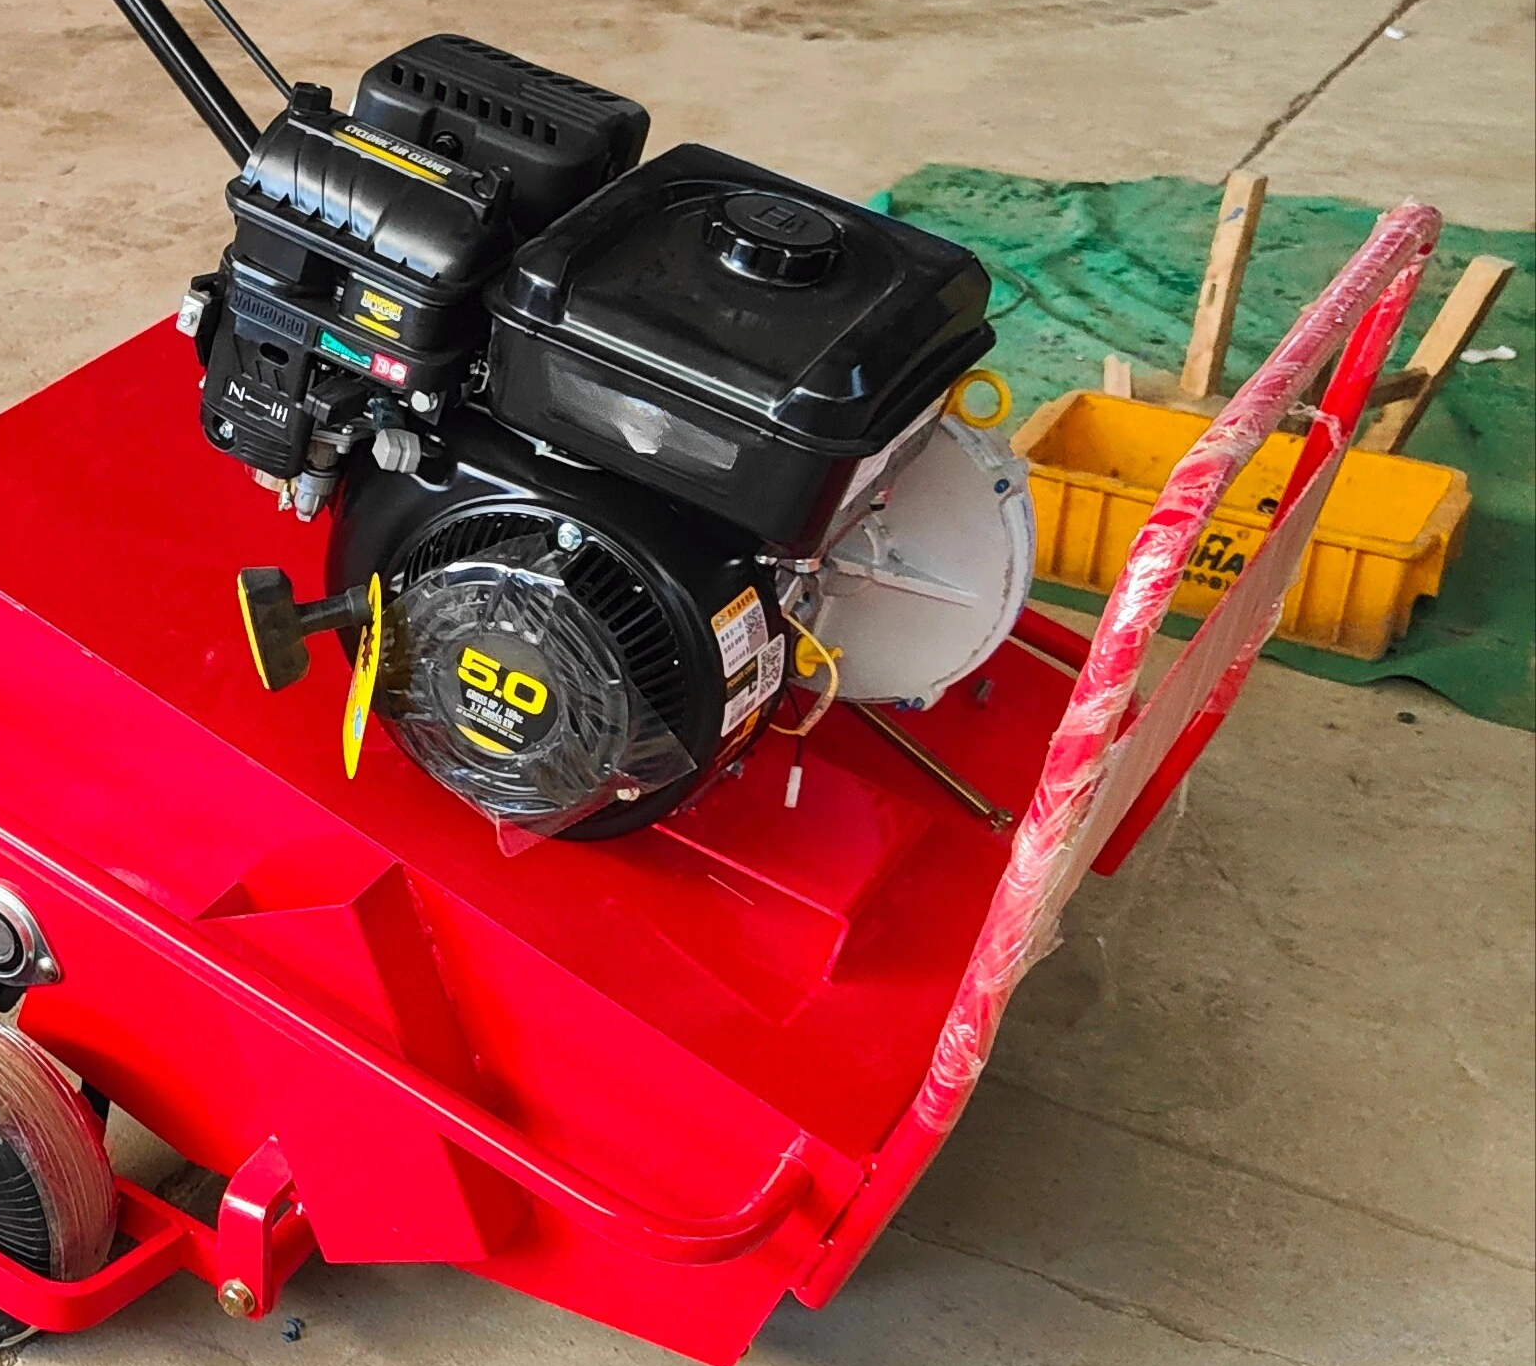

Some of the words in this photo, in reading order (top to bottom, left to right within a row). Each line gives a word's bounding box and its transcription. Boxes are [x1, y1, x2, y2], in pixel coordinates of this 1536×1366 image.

[344, 124, 392, 149] CYCLONIC
[388, 143, 411, 157] AIR
[407, 152, 453, 176] CLEANER
[457, 646, 548, 715] 5.0
